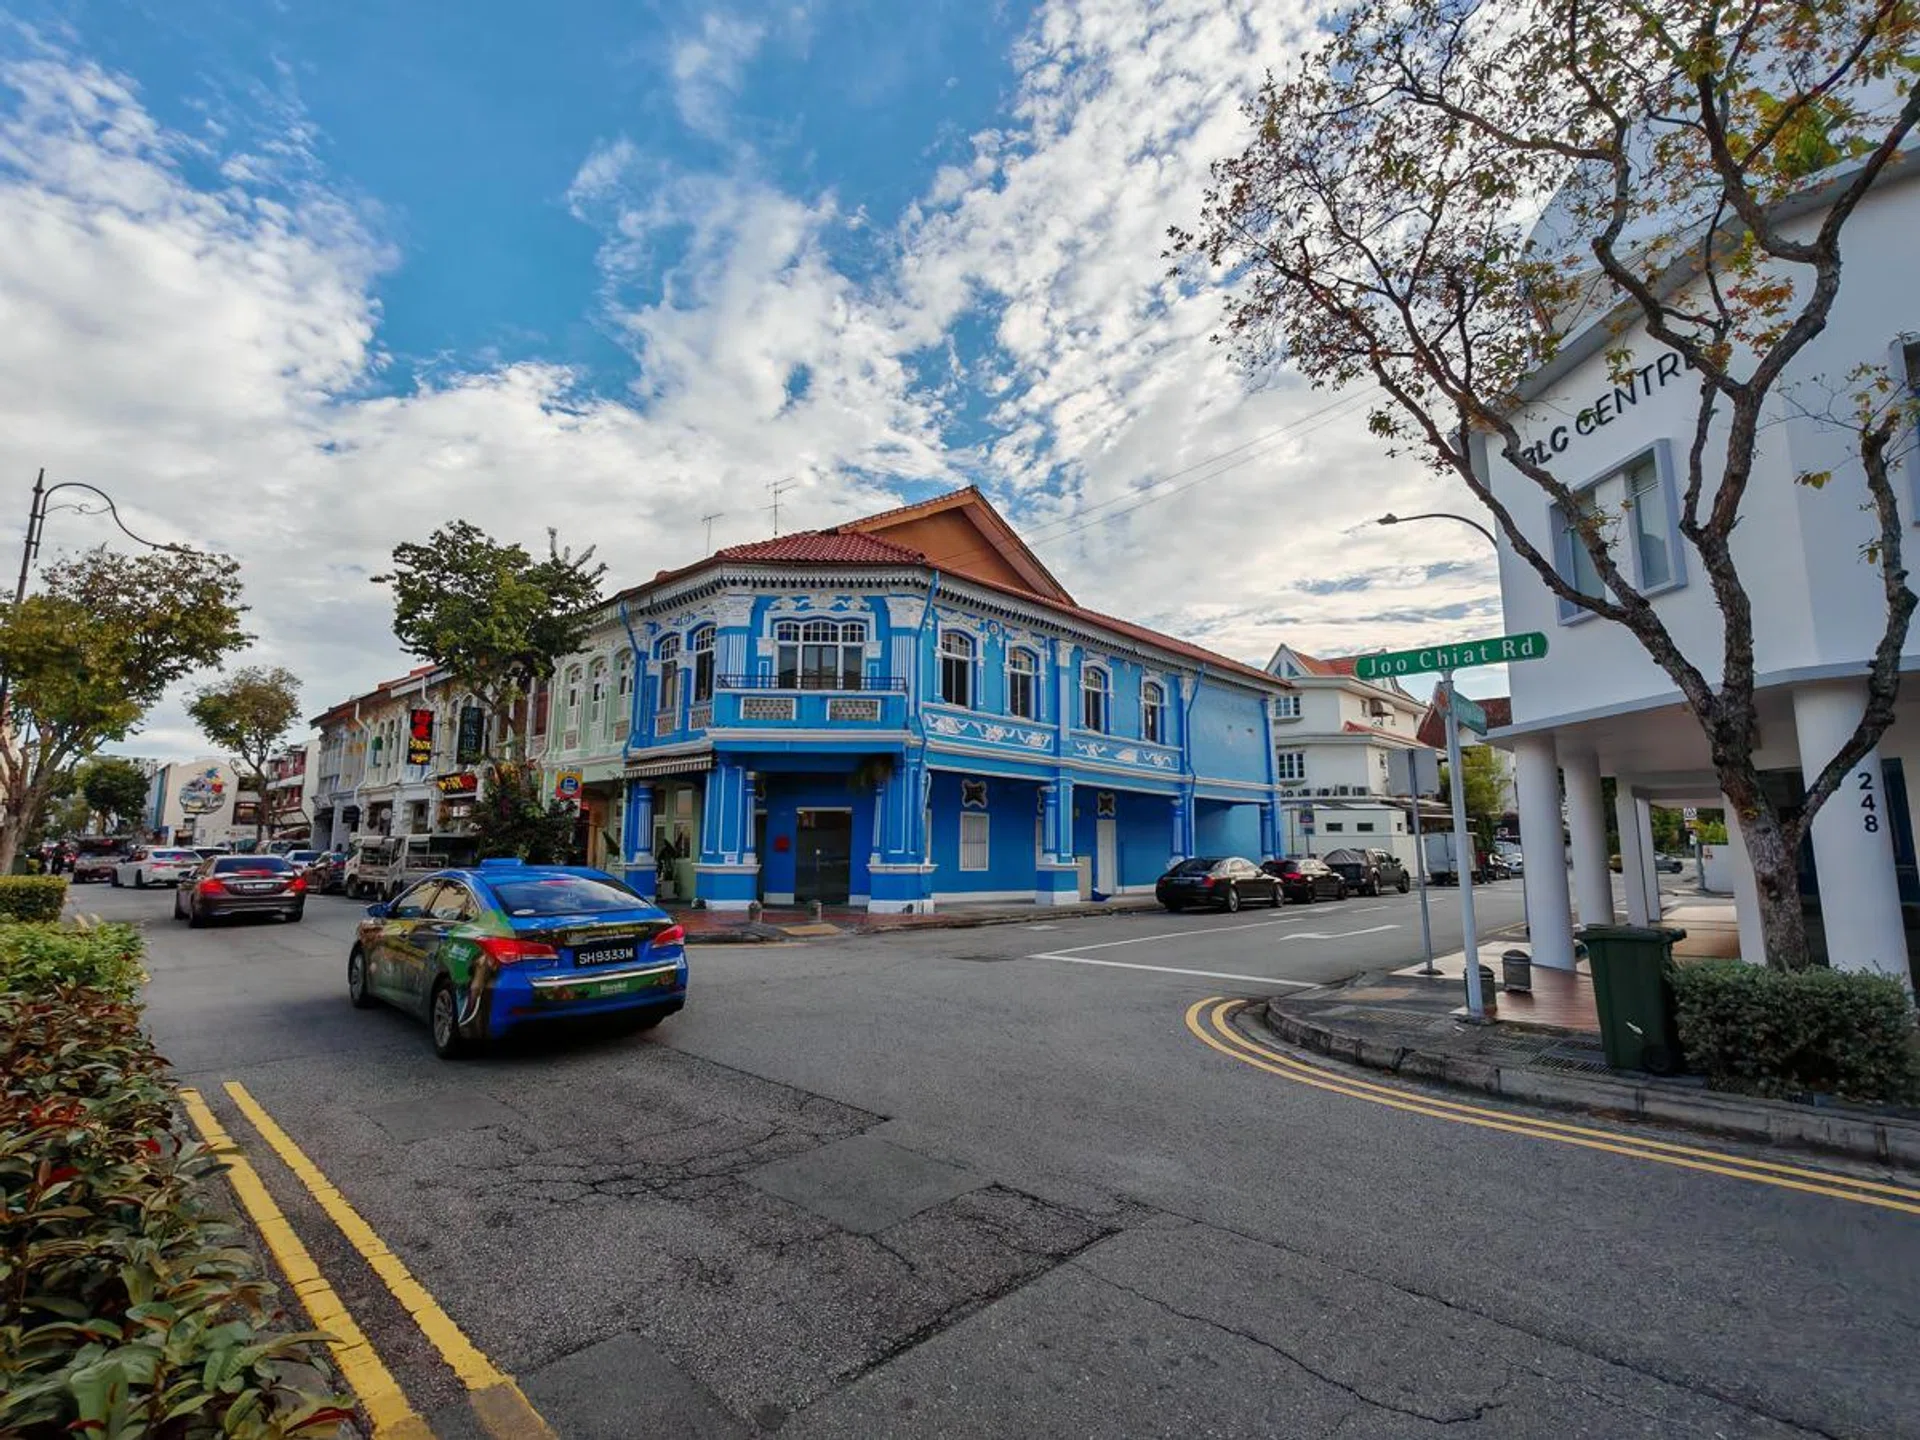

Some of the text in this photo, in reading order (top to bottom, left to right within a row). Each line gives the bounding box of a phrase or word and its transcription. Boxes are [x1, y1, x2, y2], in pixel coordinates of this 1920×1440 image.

[1368, 636, 1533, 677] Joo Chiat Rd
[1858, 772, 1879, 833] 248
[579, 948, 634, 965] SH9333M
